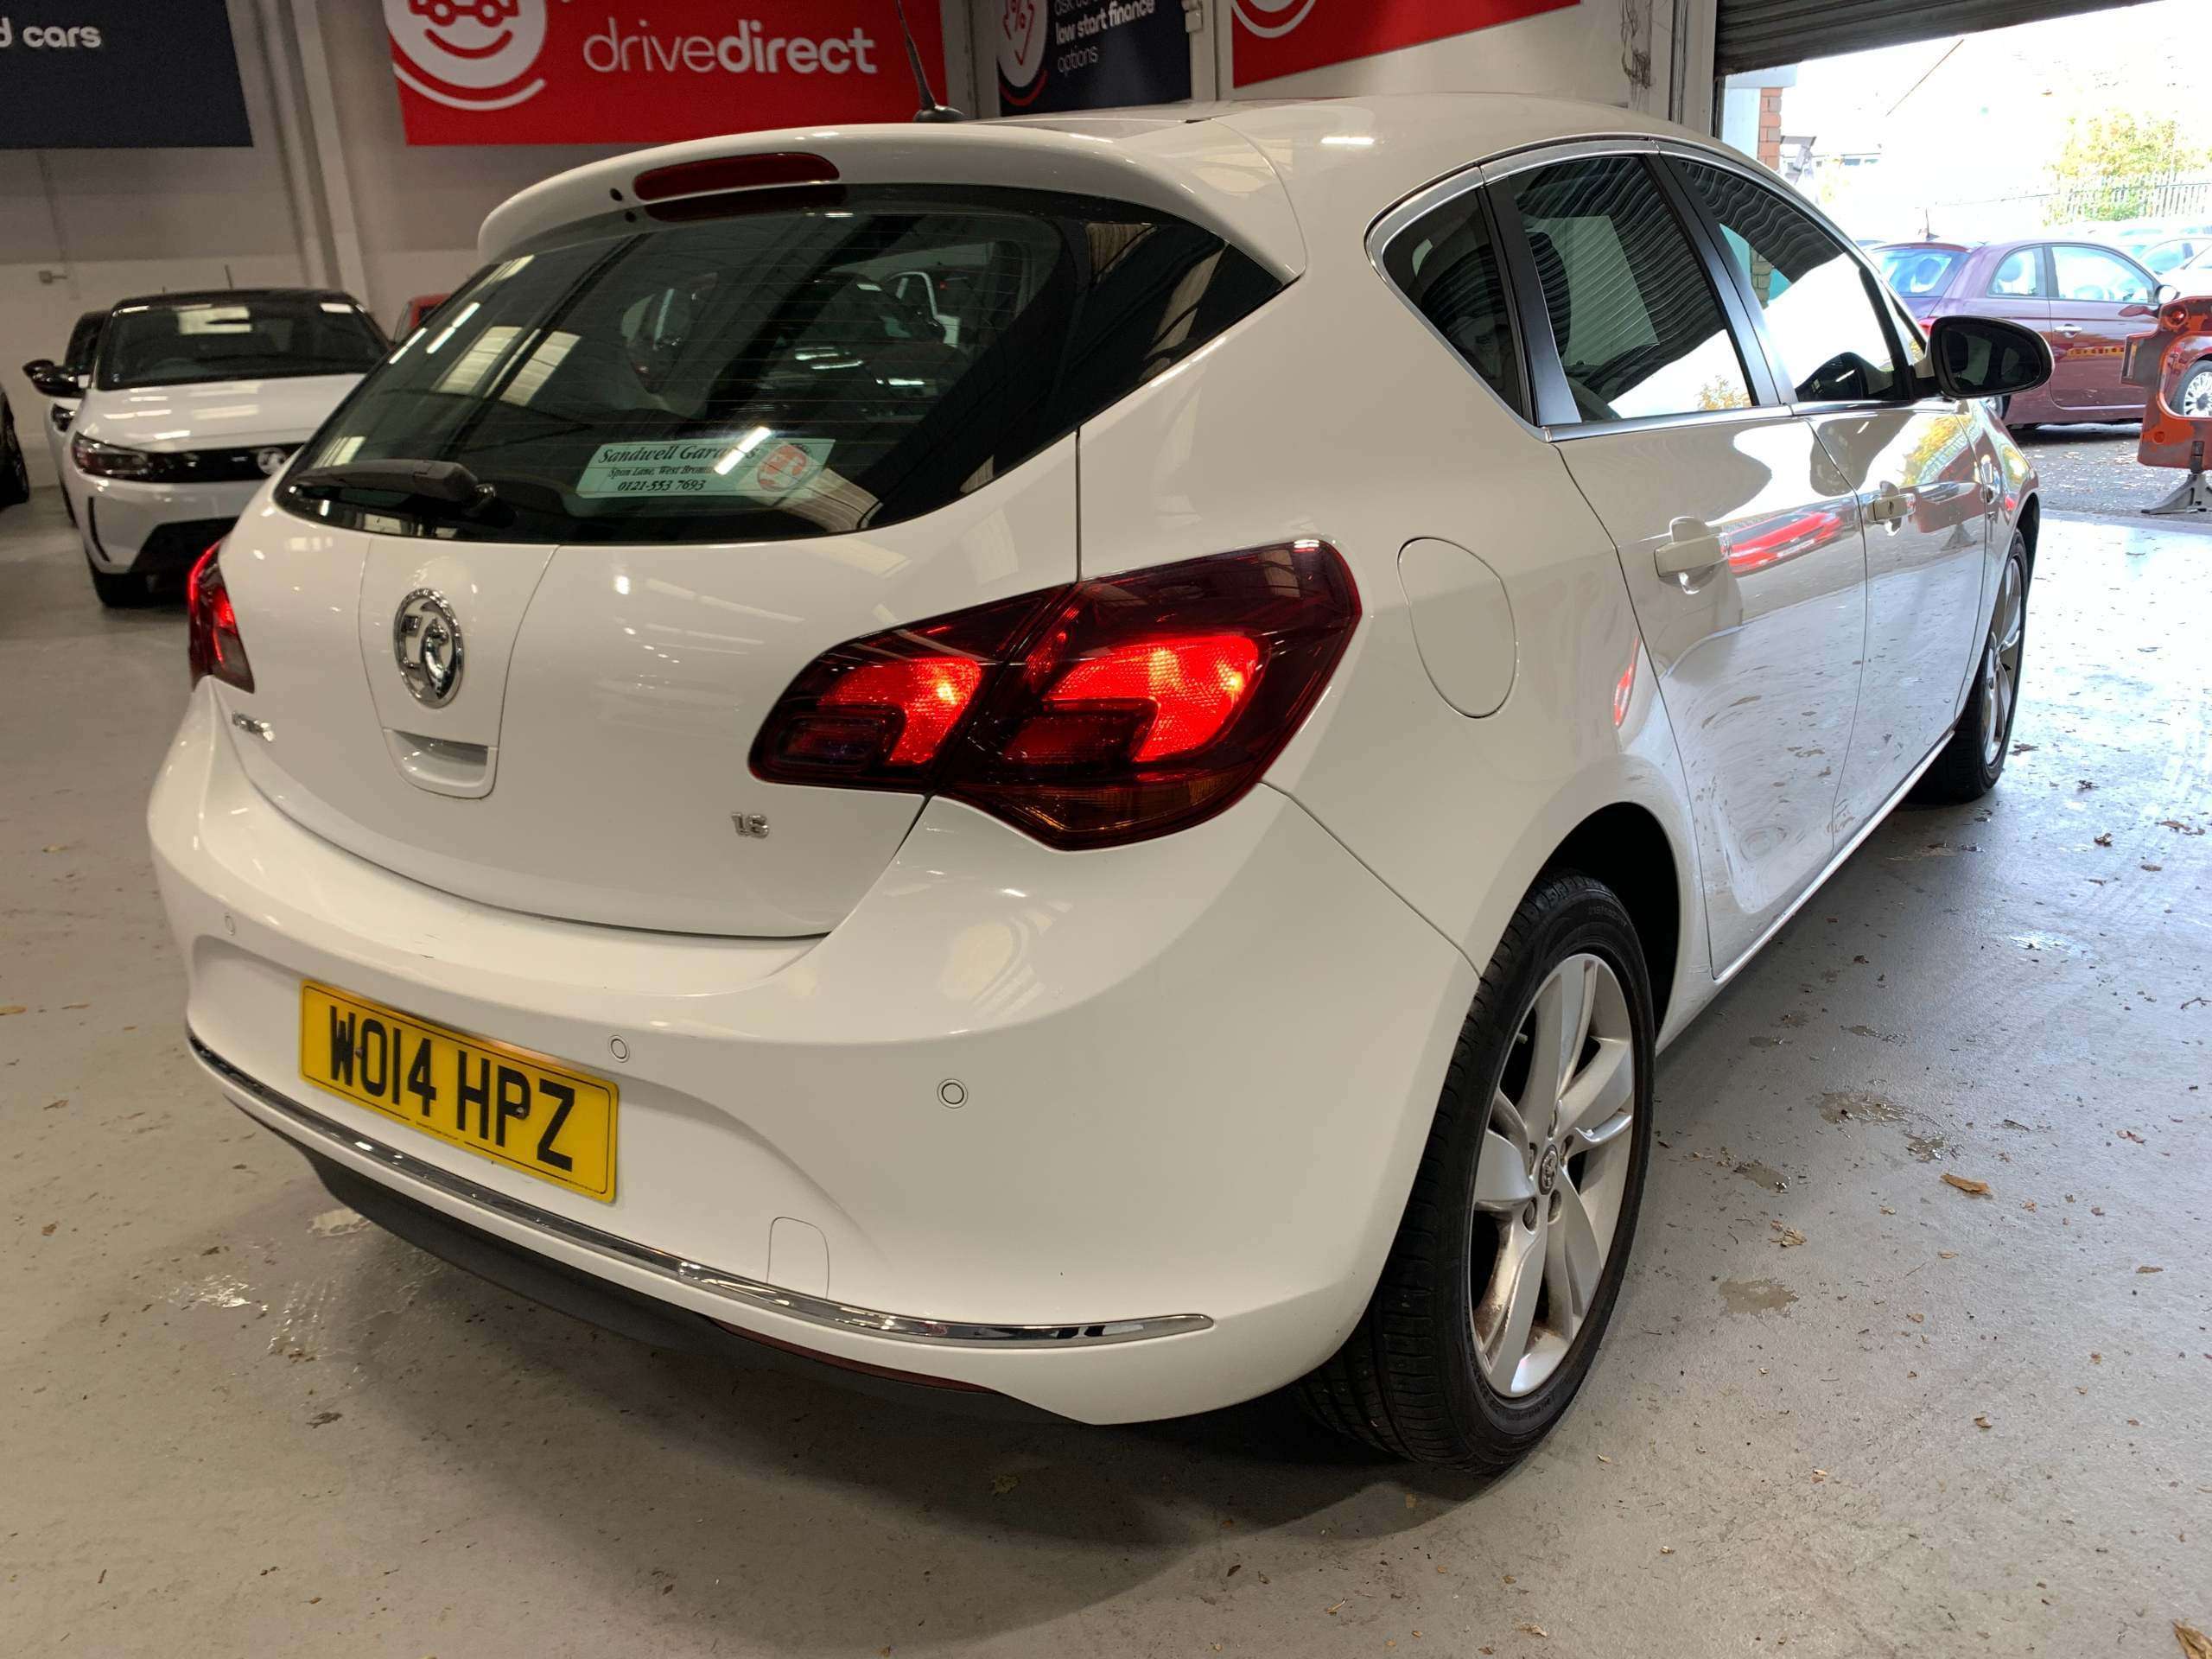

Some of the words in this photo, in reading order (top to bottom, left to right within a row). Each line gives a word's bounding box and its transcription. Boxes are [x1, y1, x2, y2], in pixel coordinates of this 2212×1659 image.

[22, 26, 102, 48] cars
[1055, 22, 1076, 45] low
[1077, 7, 1108, 38] start
[1108, 0, 1155, 27] finance
[582, 16, 878, 74] drivedirect
[1057, 44, 1099, 78] options
[598, 445, 679, 464] Sandwell
[679, 445, 760, 461] Garas
[617, 480, 675, 492] 0121-553
[677, 479, 707, 491] 7693
[329, 1005, 437, 1117] WO14
[456, 1049, 575, 1173] HPZ
